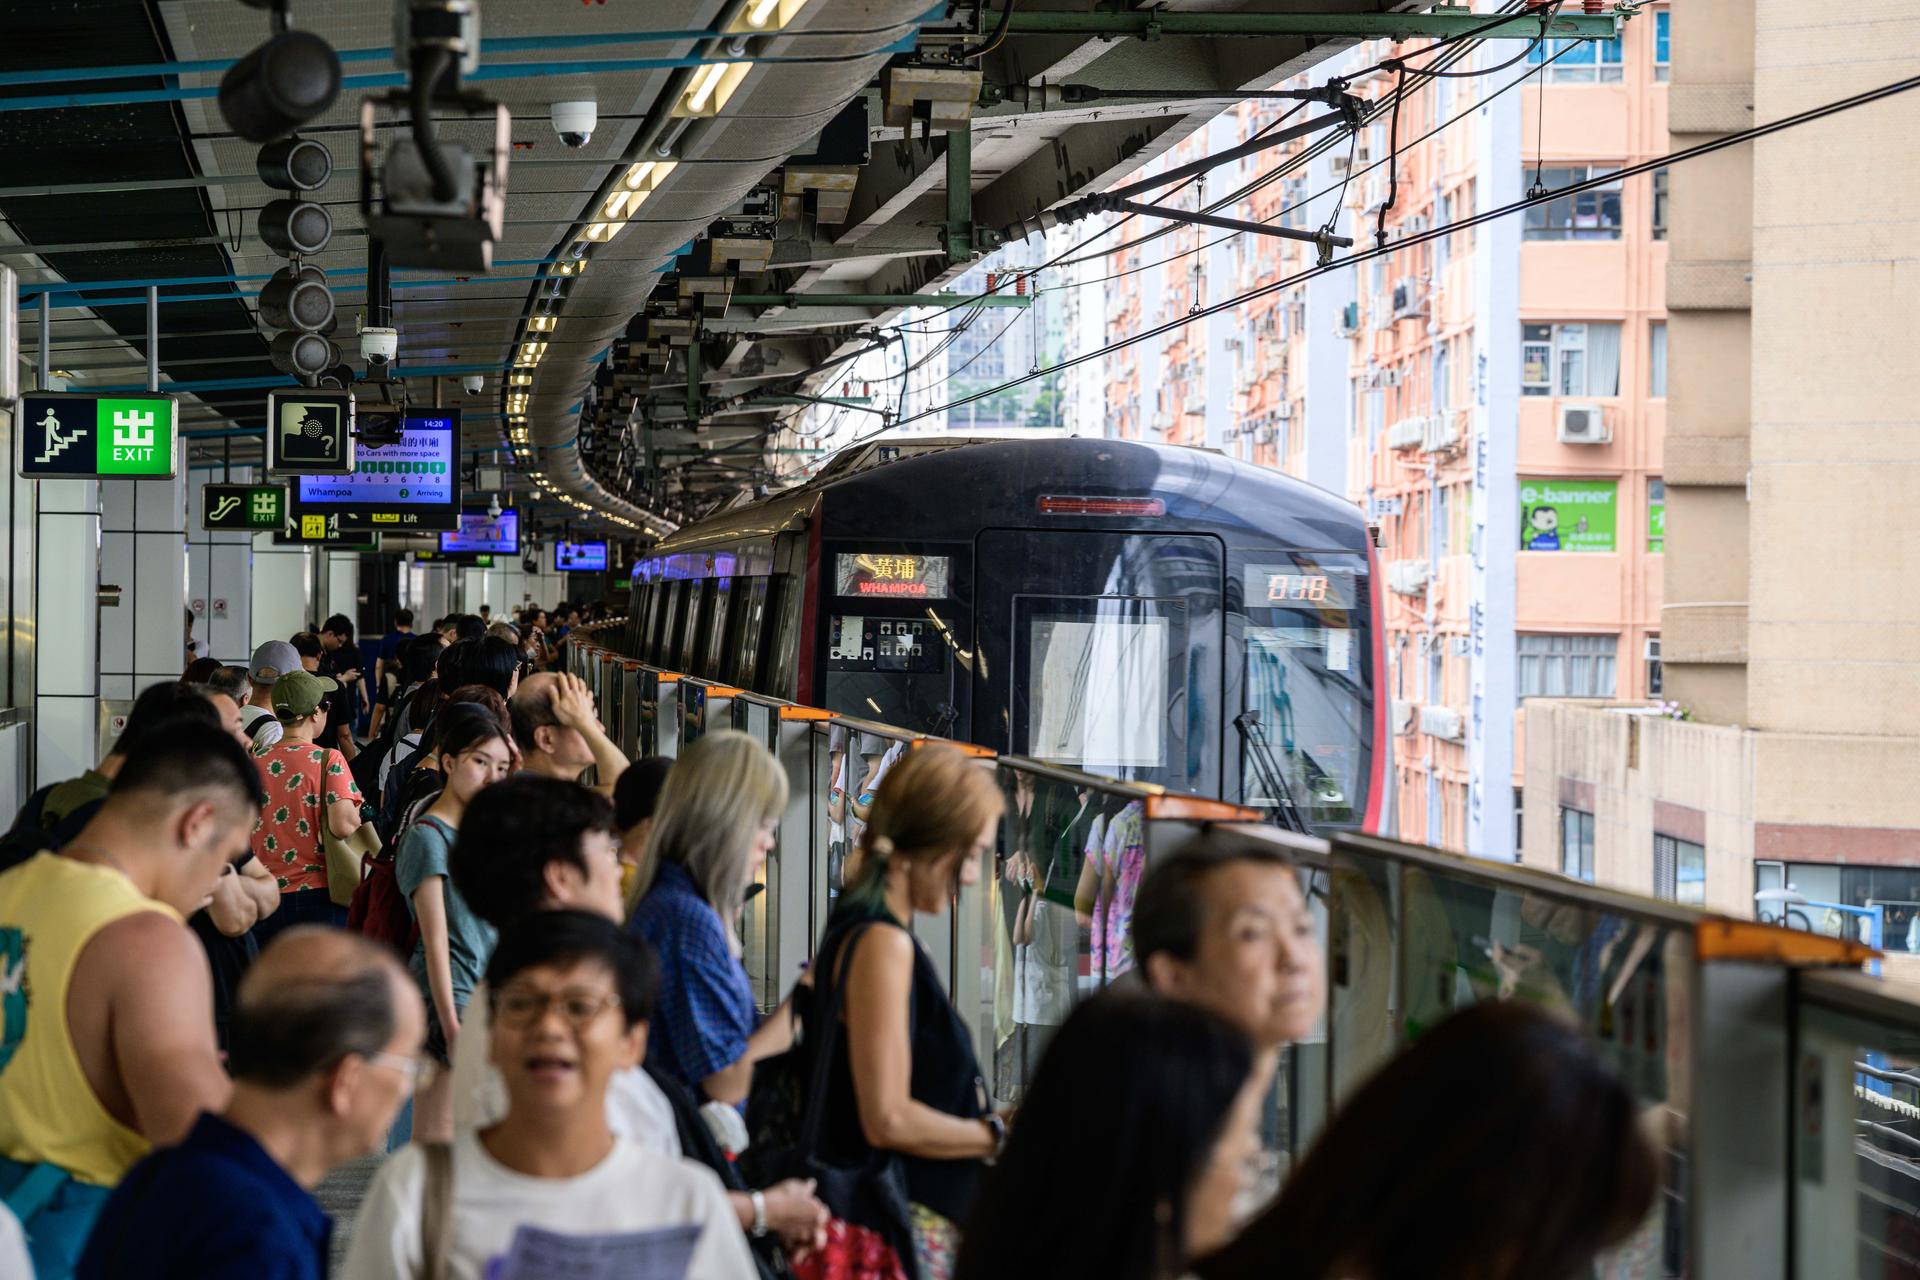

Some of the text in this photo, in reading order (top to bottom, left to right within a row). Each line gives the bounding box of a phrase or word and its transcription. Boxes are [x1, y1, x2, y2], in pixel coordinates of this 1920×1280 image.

[424, 420, 443, 428] 14:20
[113, 448, 154, 461] EXIT
[308, 488, 352, 497] Whampoa
[417, 489, 443, 498] Arriving
[1521, 486, 1613, 504] e-banner
[253, 514, 276, 522] EXIT
[403, 513, 418, 523] Lift
[327, 531, 340, 539] Lift
[873, 558, 915, 580] 黃埔
[859, 582, 927, 594] WHAMPOA
